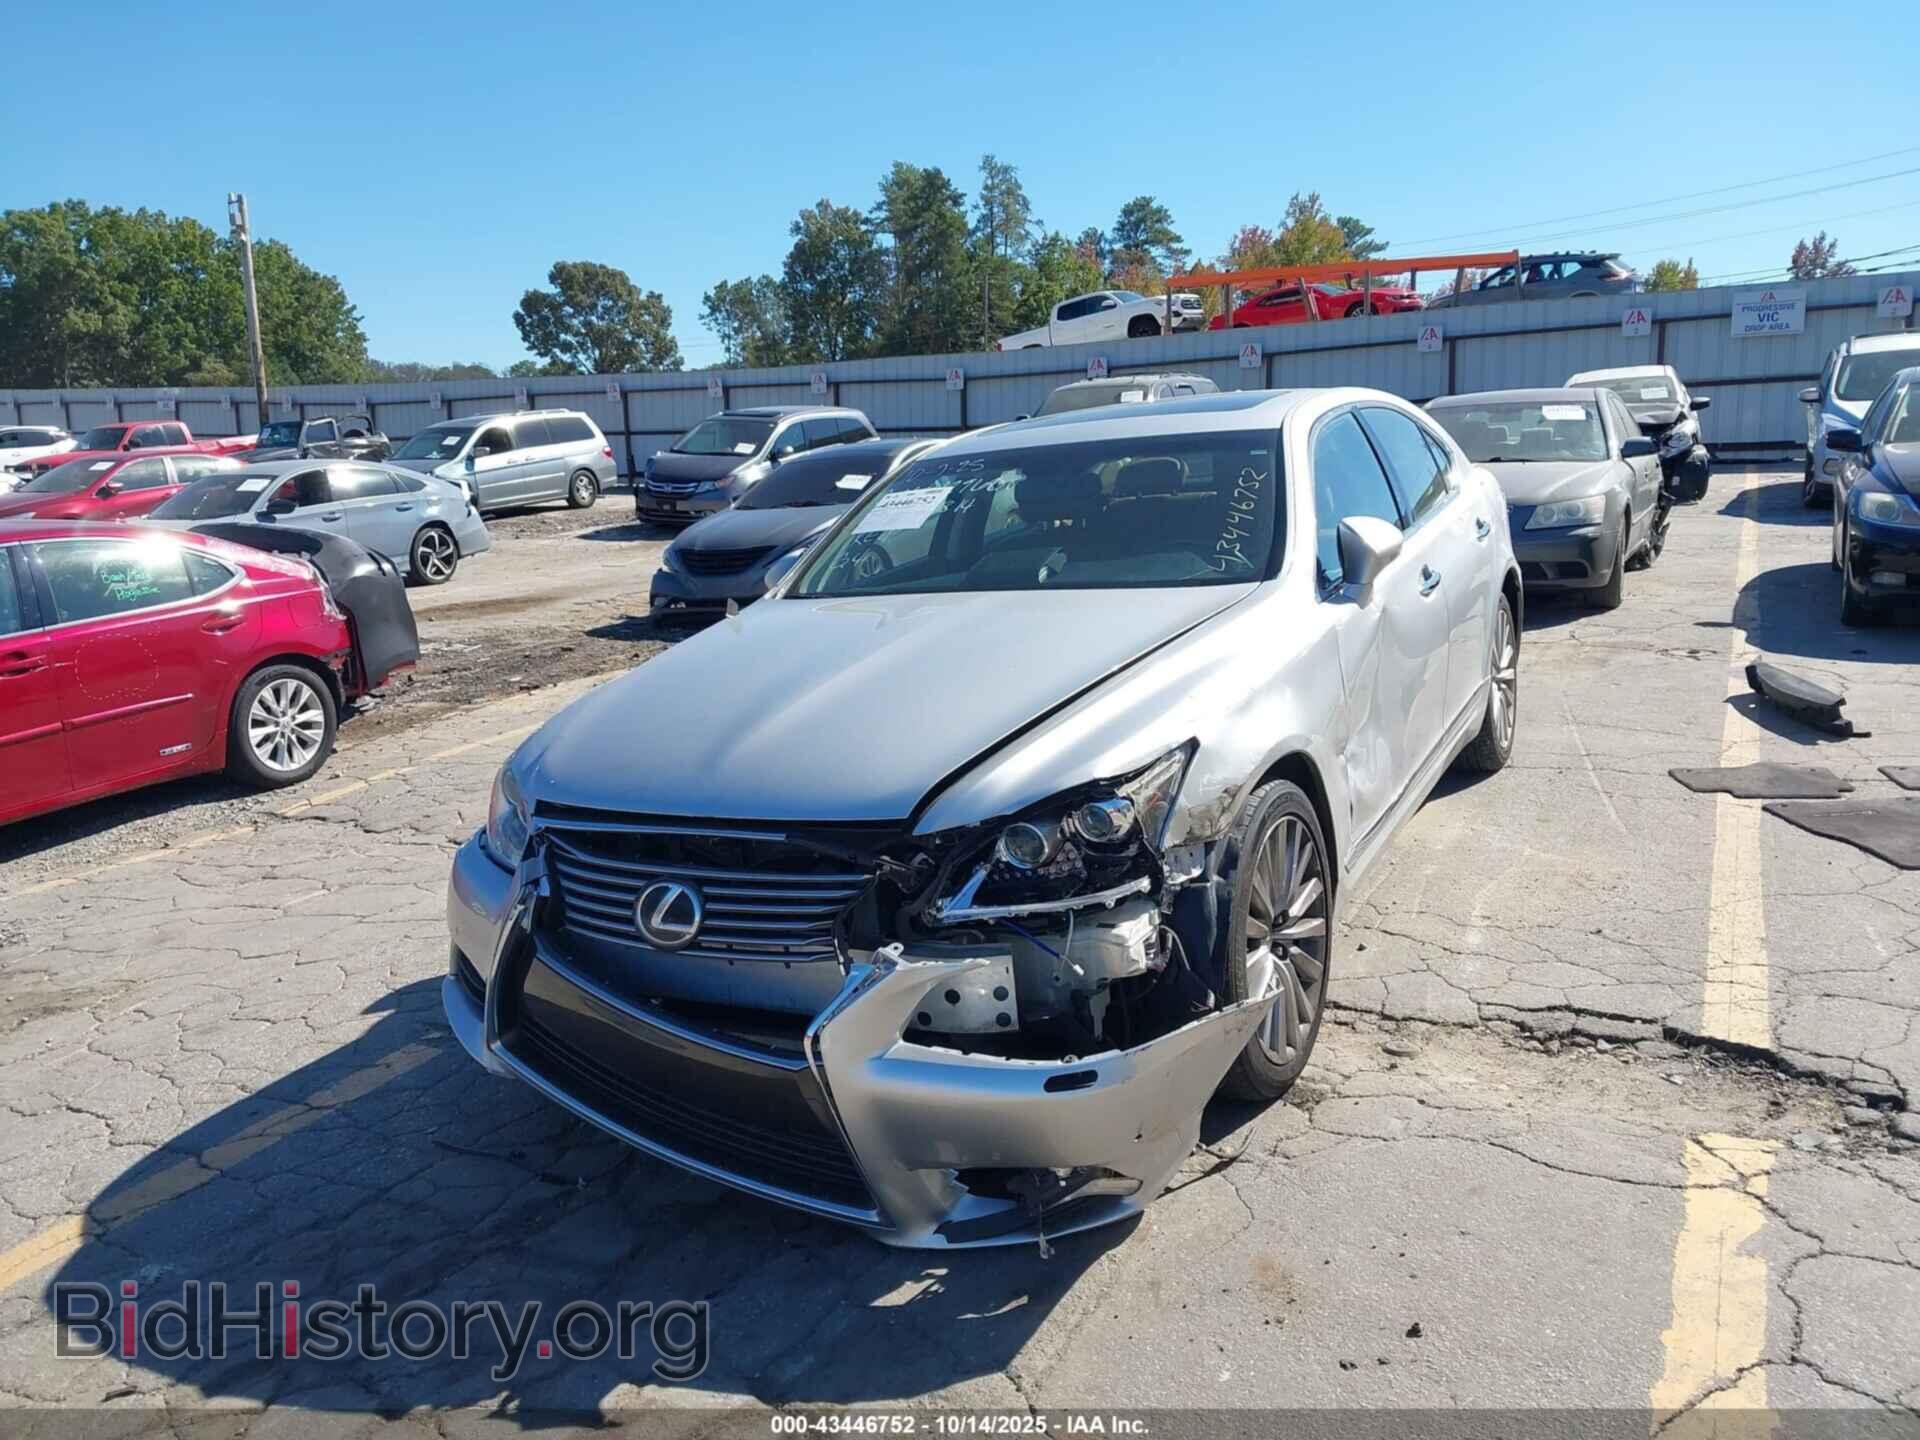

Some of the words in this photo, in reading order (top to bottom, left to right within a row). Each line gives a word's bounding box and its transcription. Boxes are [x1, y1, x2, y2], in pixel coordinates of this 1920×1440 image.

[1757, 311, 1780, 323] VIC
[1768, 323, 1790, 332] AREA
[1207, 466, 1268, 572] 43446752
